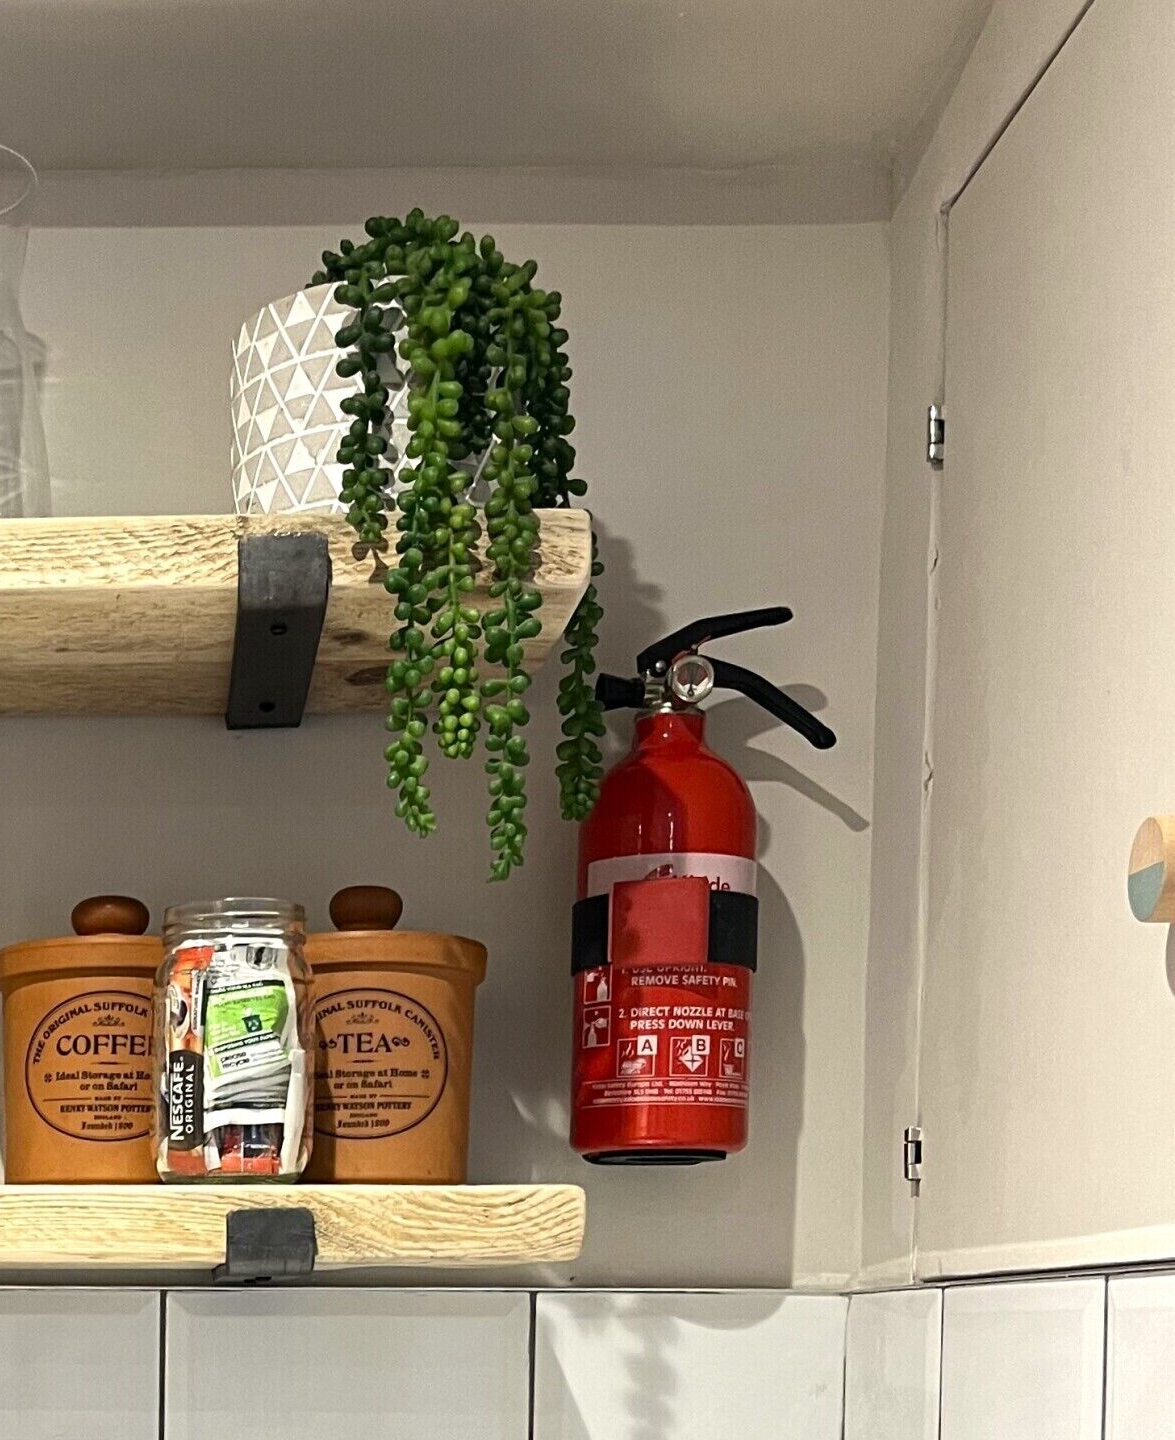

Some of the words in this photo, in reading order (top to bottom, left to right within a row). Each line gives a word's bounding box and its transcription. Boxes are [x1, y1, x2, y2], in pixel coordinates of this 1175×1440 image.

[631, 975, 679, 986] REMOVE
[682, 975, 721, 986] SAFETY
[630, 1006, 671, 1017] DIRECT
[672, 1006, 713, 1017] NOZZLE
[715, 1007, 726, 1018] AT
[346, 1000, 402, 1014] SUFFOLK
[404, 1009, 441, 1060] CANISTER
[630, 1019, 665, 1030] PRESS
[668, 1019, 703, 1030] DOWN
[32, 1040, 46, 1065] THE
[43, 1004, 92, 1040] ORIGINAL
[93, 1001, 148, 1018] SUFFOLK
[337, 1032, 392, 1054] TEA
[641, 1038, 654, 1053] A
[696, 1039, 707, 1052] B
[736, 1041, 744, 1054] C
[56, 1071, 80, 1081] Ideal
[81, 1070, 122, 1081] Storage
[123, 1070, 133, 1080] at
[335, 1069, 375, 1080] Storage
[377, 1069, 388, 1078] at
[390, 1068, 418, 1078] Home
[106, 1081, 138, 1091] Safari
[360, 1080, 393, 1089] Safari
[185, 1064, 195, 1134] ORIGINAL
[87, 1104, 119, 1113] WATSON
[343, 1101, 375, 1110] WATSON
[377, 1101, 412, 1110] POTTERY
